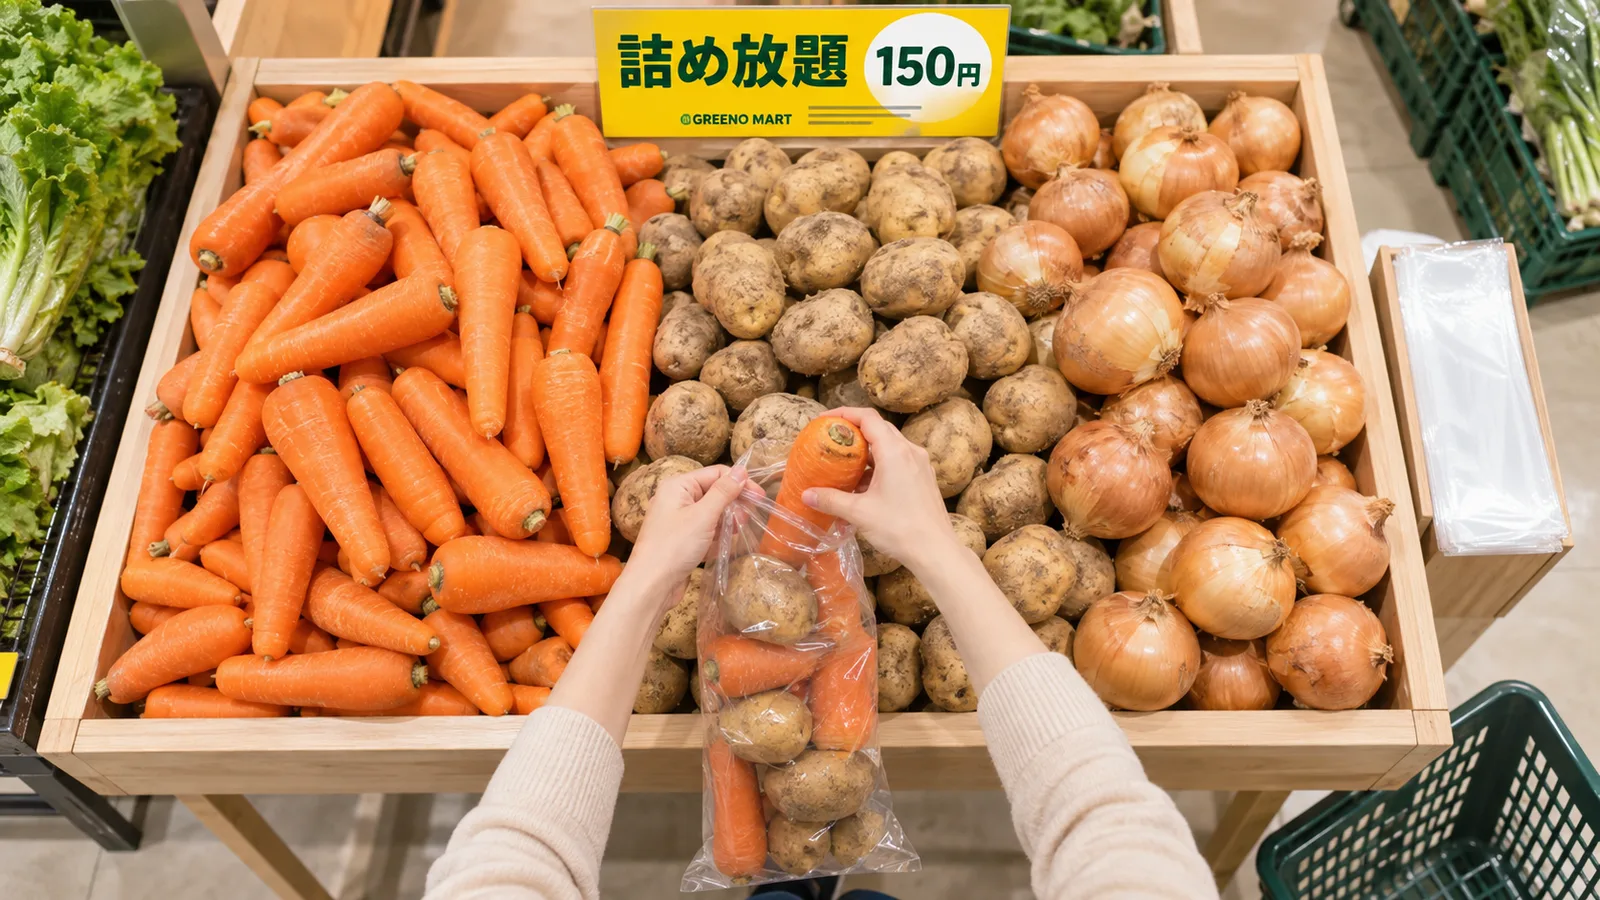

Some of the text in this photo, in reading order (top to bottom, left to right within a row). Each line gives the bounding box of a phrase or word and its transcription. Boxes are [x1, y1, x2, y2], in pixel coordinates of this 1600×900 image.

[617, 33, 849, 89] 詰め放題
[876, 45, 981, 87] 150円
[692, 113, 793, 125] GREENO MART
